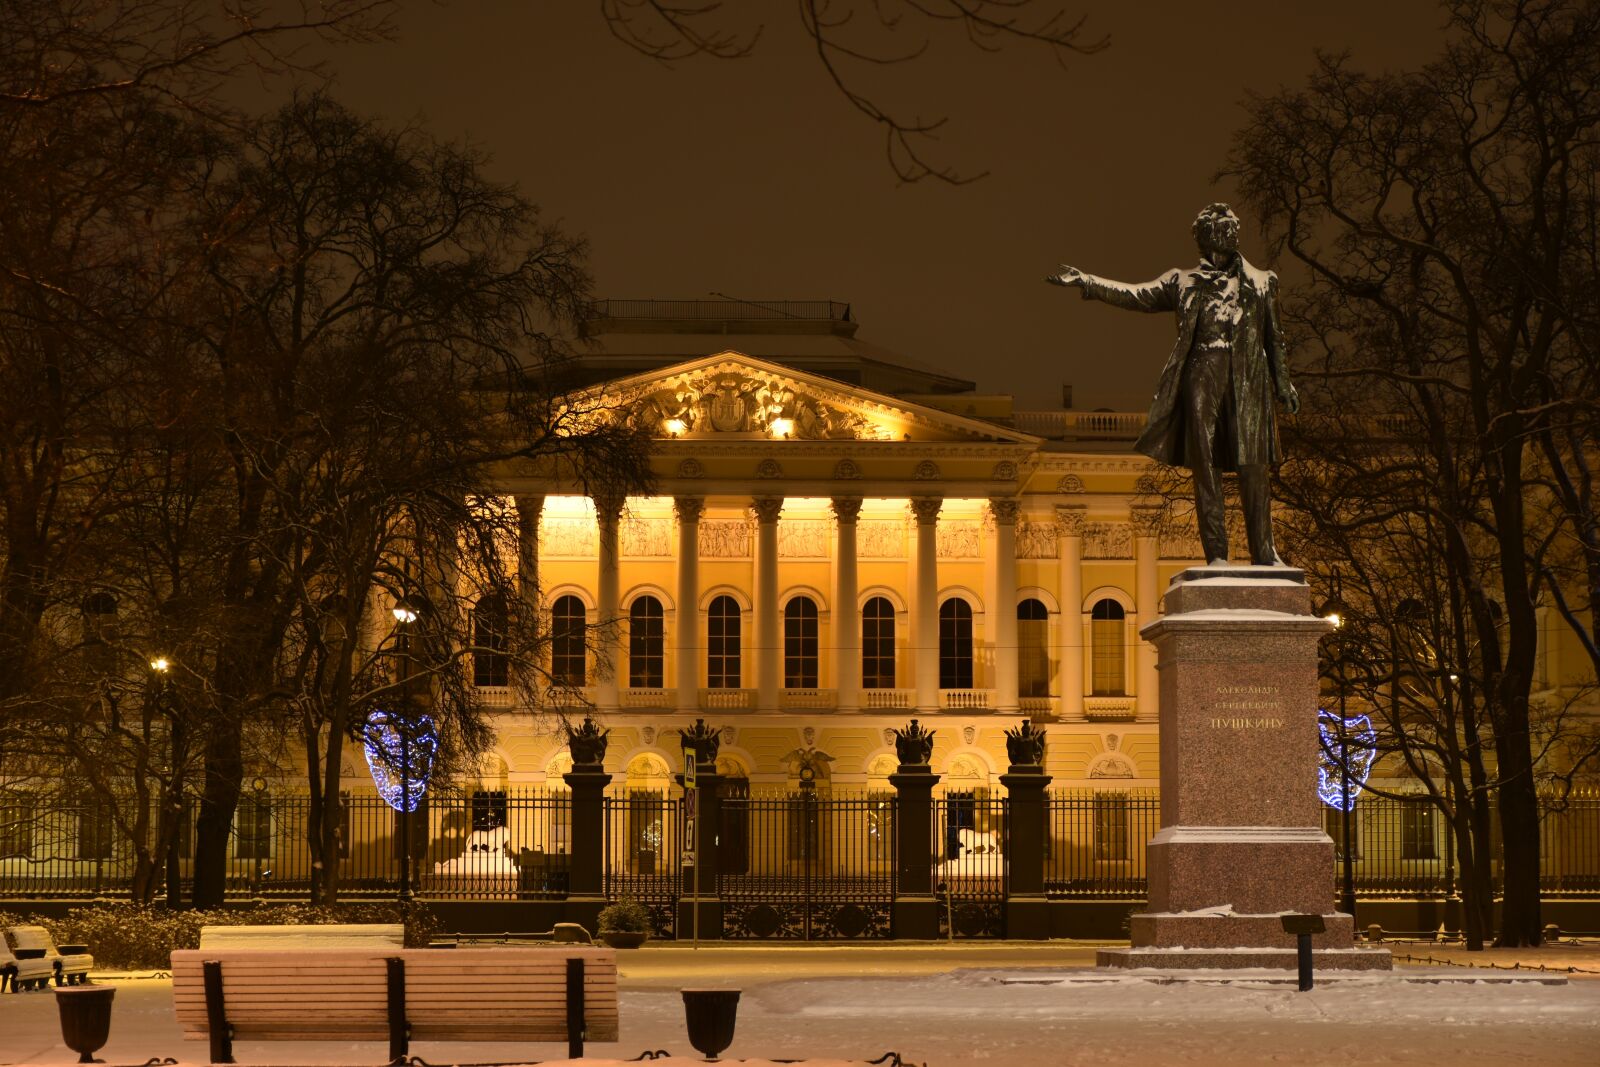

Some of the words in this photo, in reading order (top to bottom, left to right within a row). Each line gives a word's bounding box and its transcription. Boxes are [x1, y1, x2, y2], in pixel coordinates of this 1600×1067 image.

[1216, 686, 1280, 694] АЛЕКСАНДРУ
[1215, 701, 1280, 709] СЕРГЕЕВИЧУ
[1212, 718, 1284, 729] ПУШКИНУ
